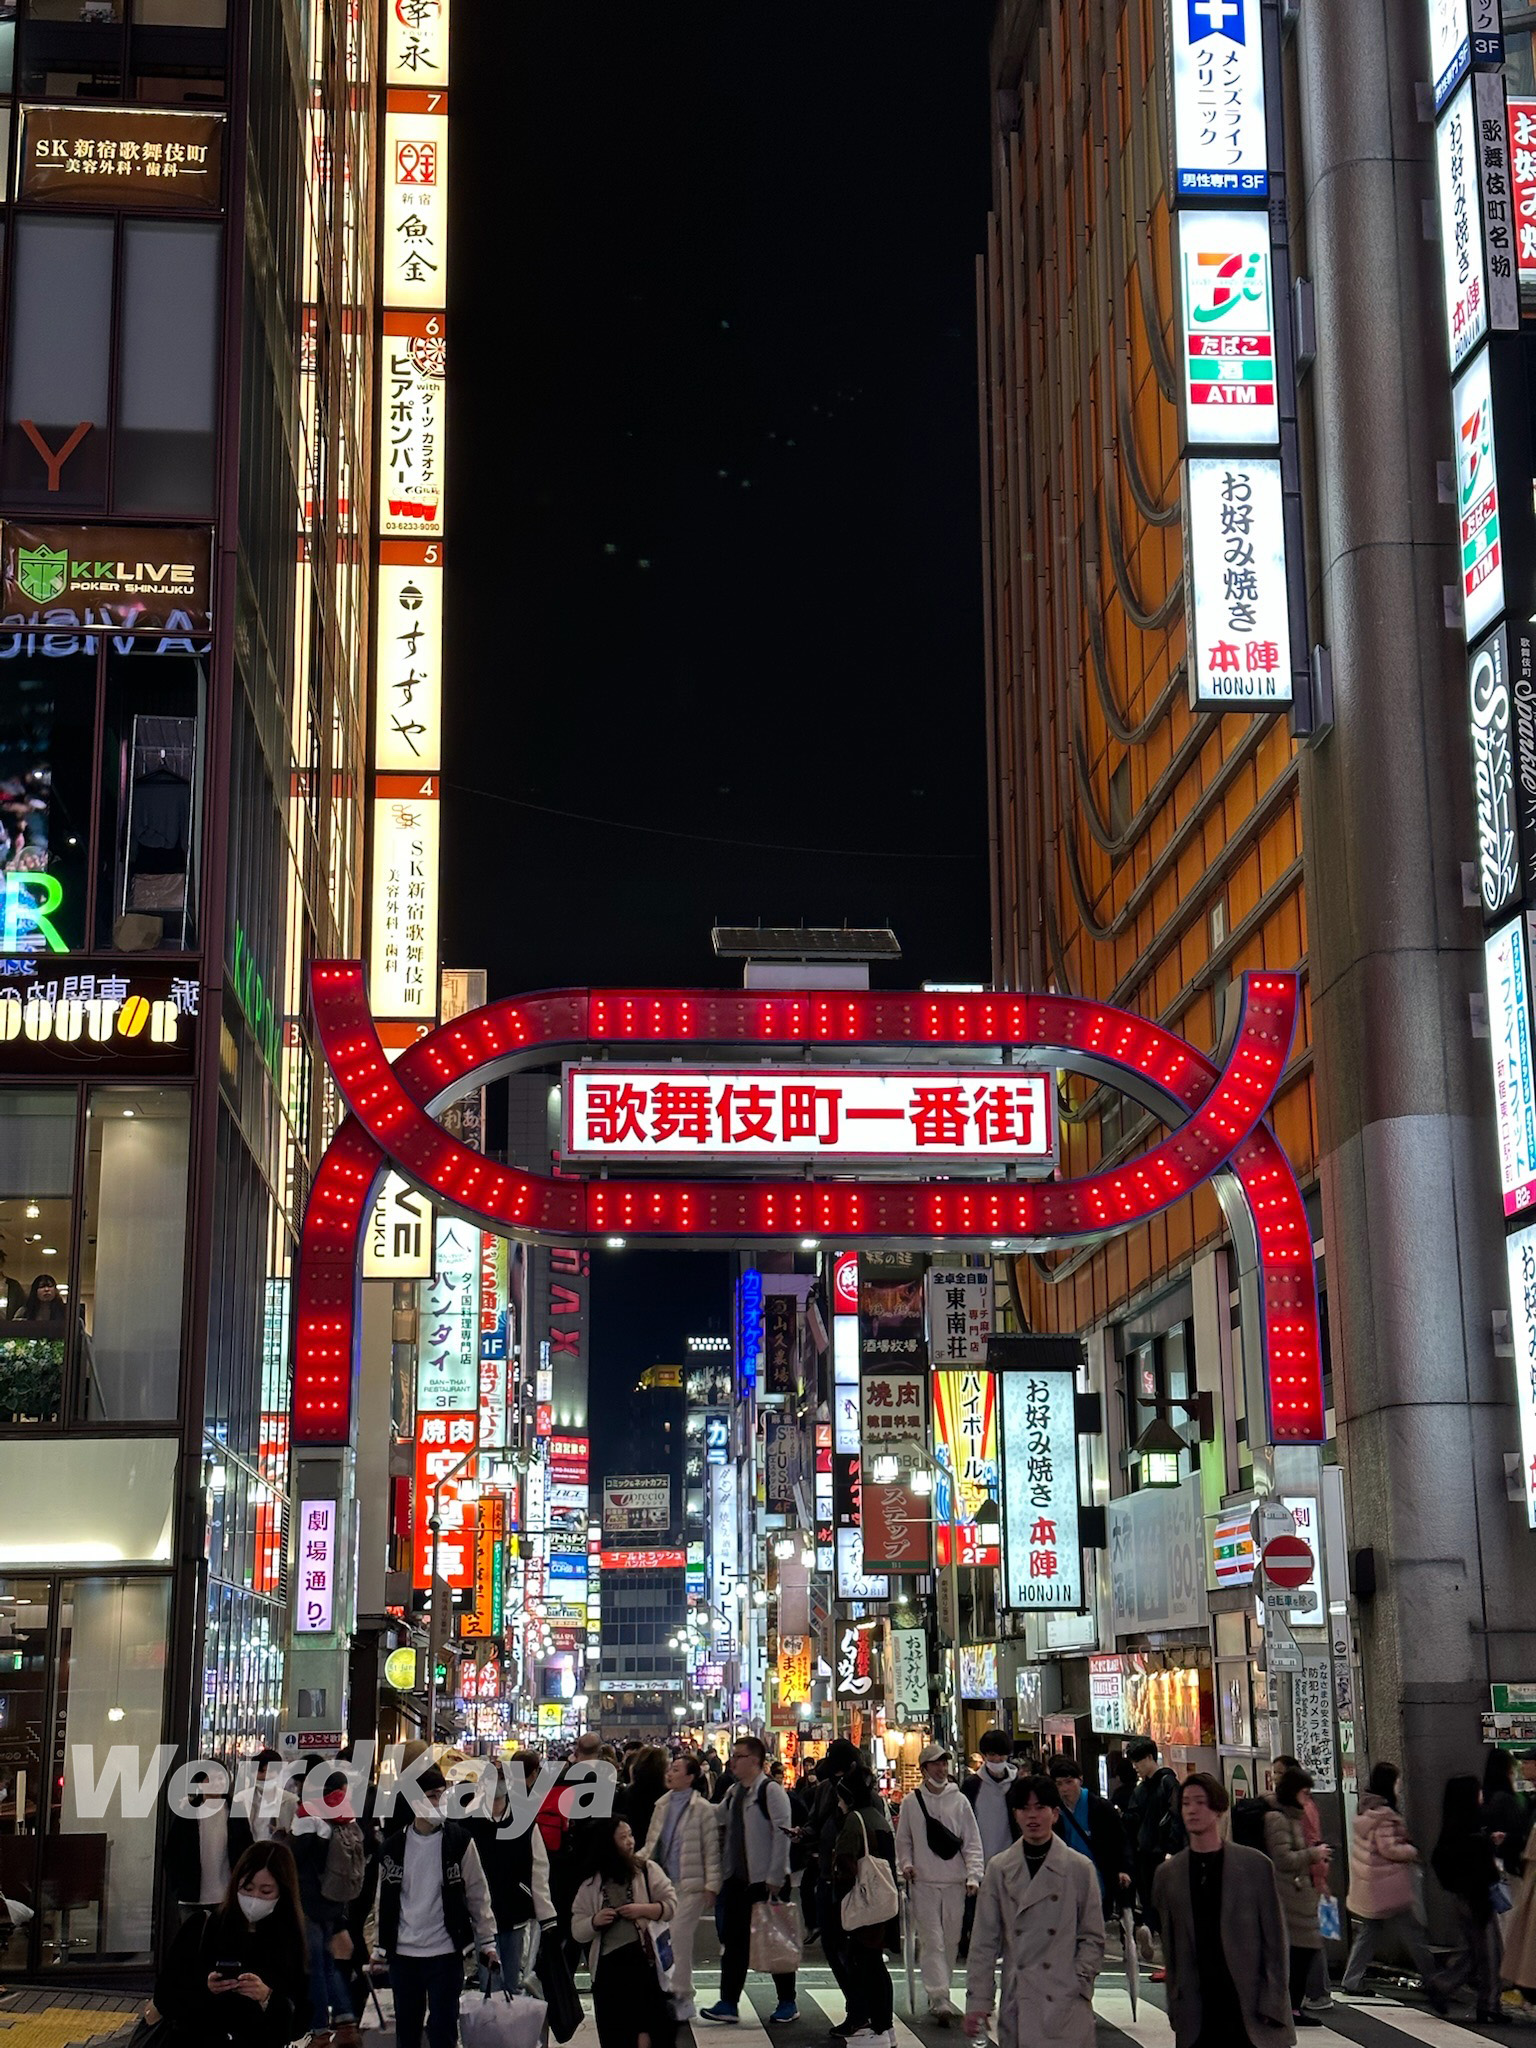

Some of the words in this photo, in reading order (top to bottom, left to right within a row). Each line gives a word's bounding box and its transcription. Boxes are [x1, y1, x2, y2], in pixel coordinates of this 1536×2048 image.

[1475, 39, 1499, 54] 3F
[427, 94, 442, 112] 7
[1197, 49, 1217, 146] クリニック
[1222, 50, 1243, 165] メンズライフ
[35, 139, 68, 158] SK
[74, 138, 208, 164] 新宿歌舞伎町
[65, 158, 178, 178] 美容外科・歯科
[1182, 173, 1238, 189] 男性専門
[1242, 175, 1264, 189] 3F
[1449, 114, 1469, 285] お好み焼き
[1482, 119, 1511, 278] 歌舞伎町名物
[396, 213, 438, 283] 魚金
[425, 316, 440, 334] 6
[1199, 336, 1260, 356] たばこ
[416, 382, 441, 392] with
[1206, 386, 1257, 403] ATM
[19, 419, 94, 492] Y
[422, 433, 434, 482] カラオケ
[424, 545, 438, 564] 5
[1220, 472, 1259, 632] お好み焼き
[71, 561, 195, 583] KKLIVE
[70, 582, 120, 592] POKER
[124, 583, 195, 595] SHINJUKU
[1209, 640, 1280, 674] 本陣
[391, 621, 428, 757] すずや
[1211, 676, 1276, 696] HONJIN
[418, 778, 433, 797] 4
[0, 994, 178, 1043] DOUTOR
[1501, 976, 1524, 1179] ファイトフィット
[586, 1081, 1034, 1147] 歌舞伎町一番街
[933, 1272, 988, 1285] 全卓全自動
[427, 1271, 456, 1372] バンタイ
[460, 1272, 472, 1366] タイ国料理専門店
[946, 1287, 967, 1359] 東南荘
[968, 1309, 979, 1352] 専門店
[482, 1339, 503, 1355] 1F
[863, 1338, 918, 1353] 酒場牧場
[435, 1395, 459, 1408] 3F
[866, 1381, 920, 1407] 焼肉
[419, 1418, 475, 1445] 焼肉
[961, 1374, 984, 1479] ハイボール
[1026, 1378, 1054, 1508] お好み焼き
[774, 1503, 791, 1513] 4F
[880, 1487, 911, 1560] ステップ
[610, 1552, 683, 1562] ゴールドラッシュ
[962, 1549, 987, 1564] 2F
[1029, 1516, 1059, 1579] 本陣
[305, 1509, 330, 1621] 劇場通り
[1018, 1584, 1072, 1602] HONJIN
[1267, 1594, 1314, 1607] 自転車を除く
[911, 1713, 930, 1723] B1F
